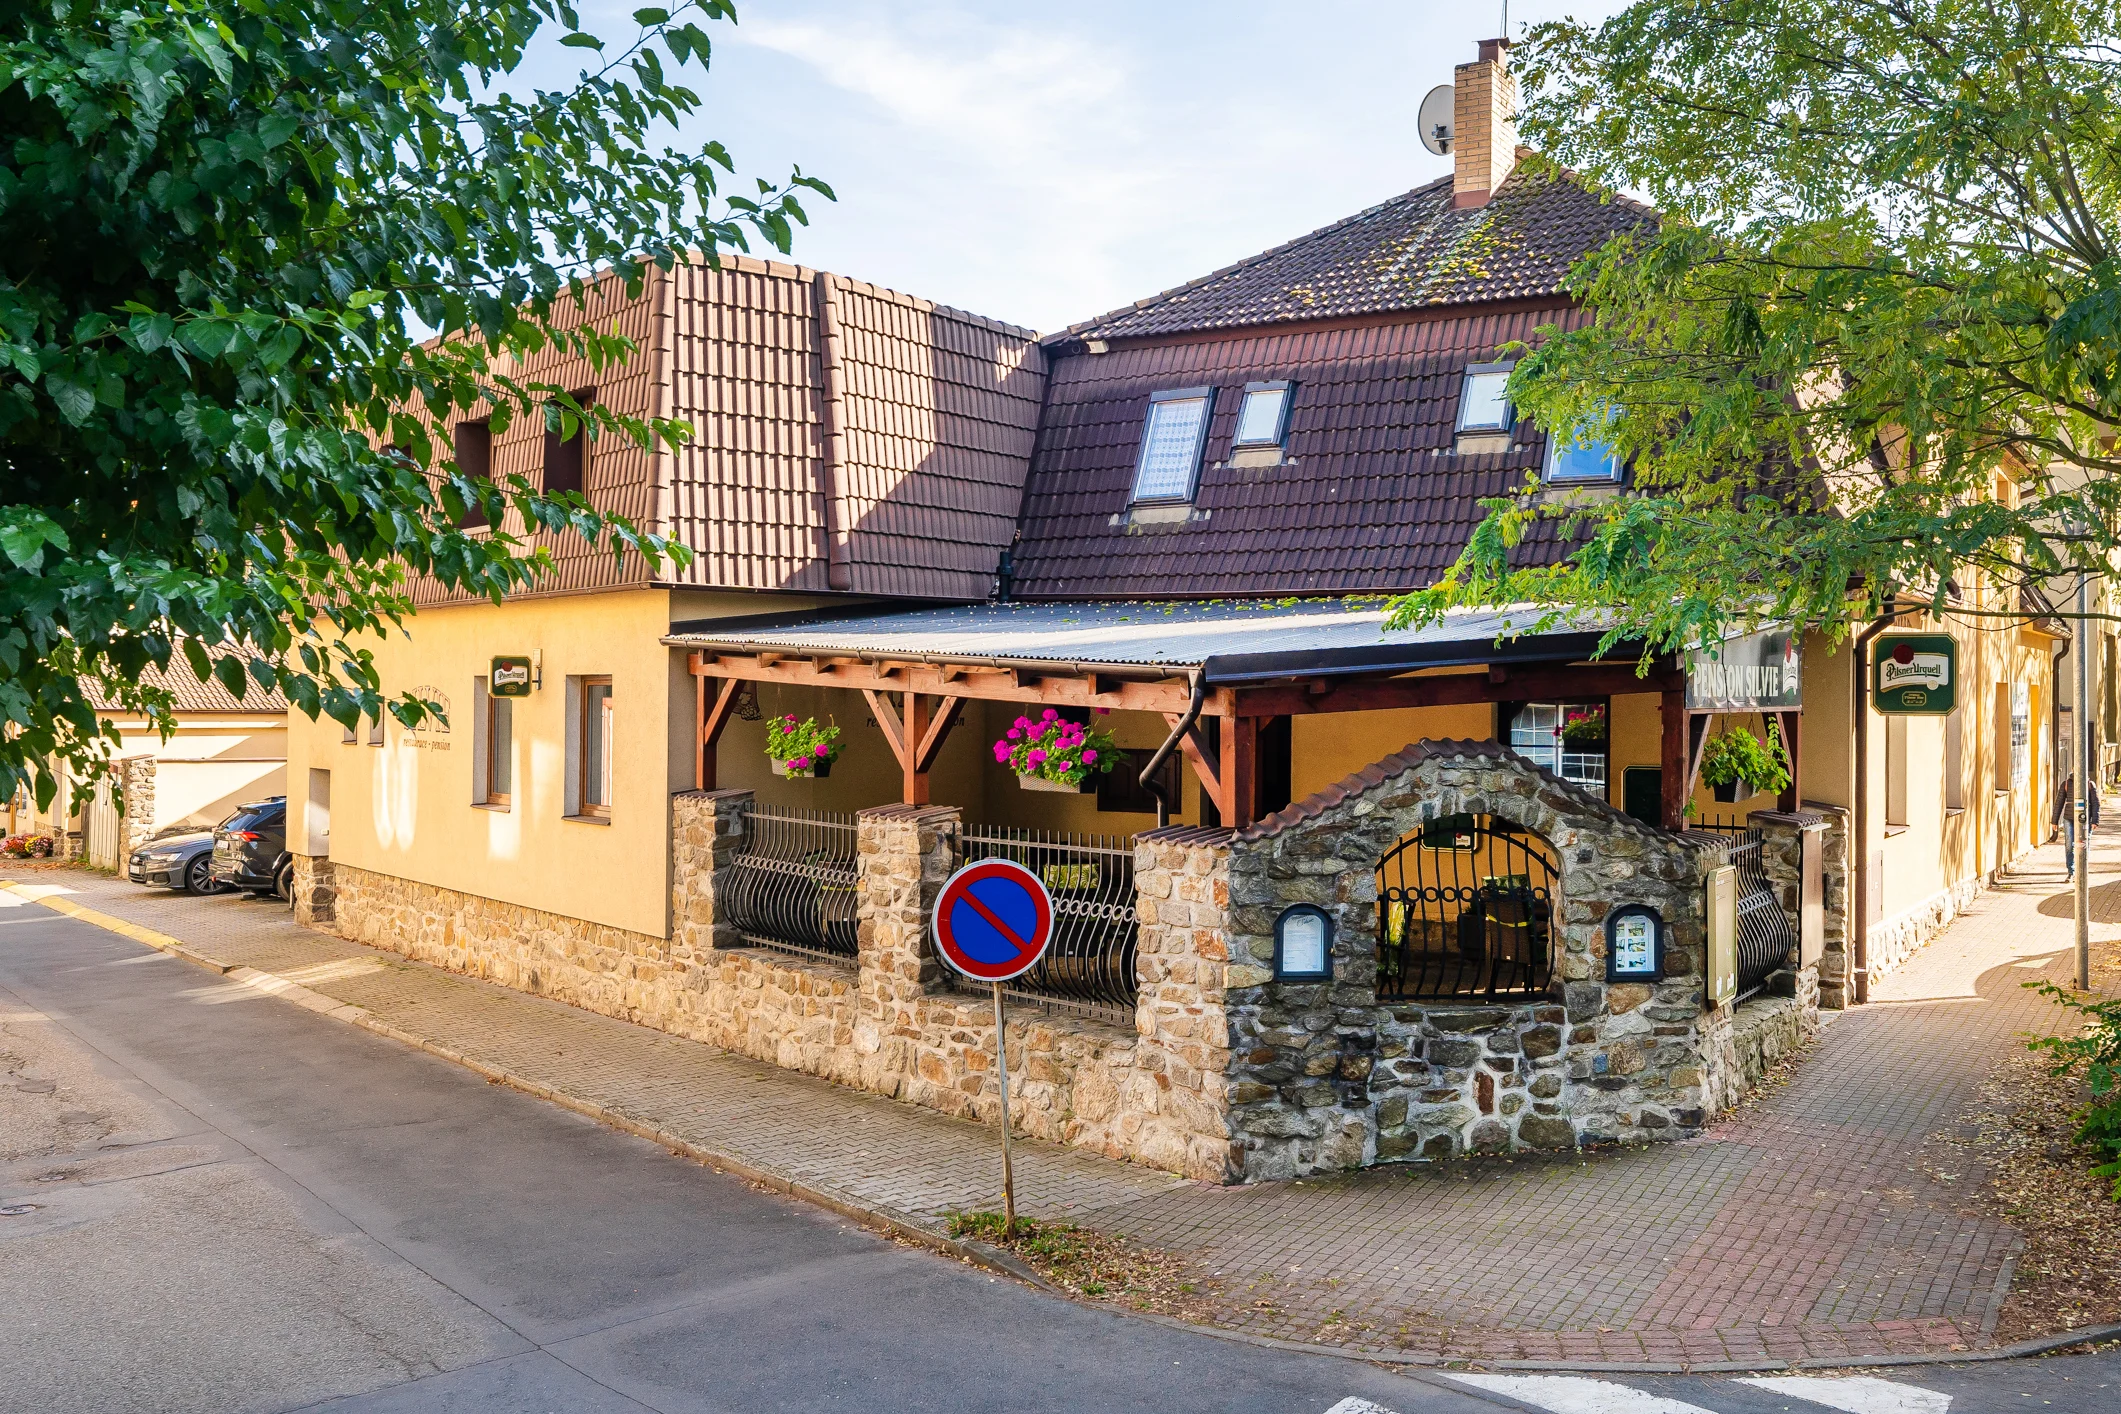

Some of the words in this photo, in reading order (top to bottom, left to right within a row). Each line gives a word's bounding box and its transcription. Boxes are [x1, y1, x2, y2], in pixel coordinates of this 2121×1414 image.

[1693, 662, 1743, 697] PENSION
[1746, 665, 1779, 697] SILVIE
[1886, 663, 1914, 681] Pilsner
